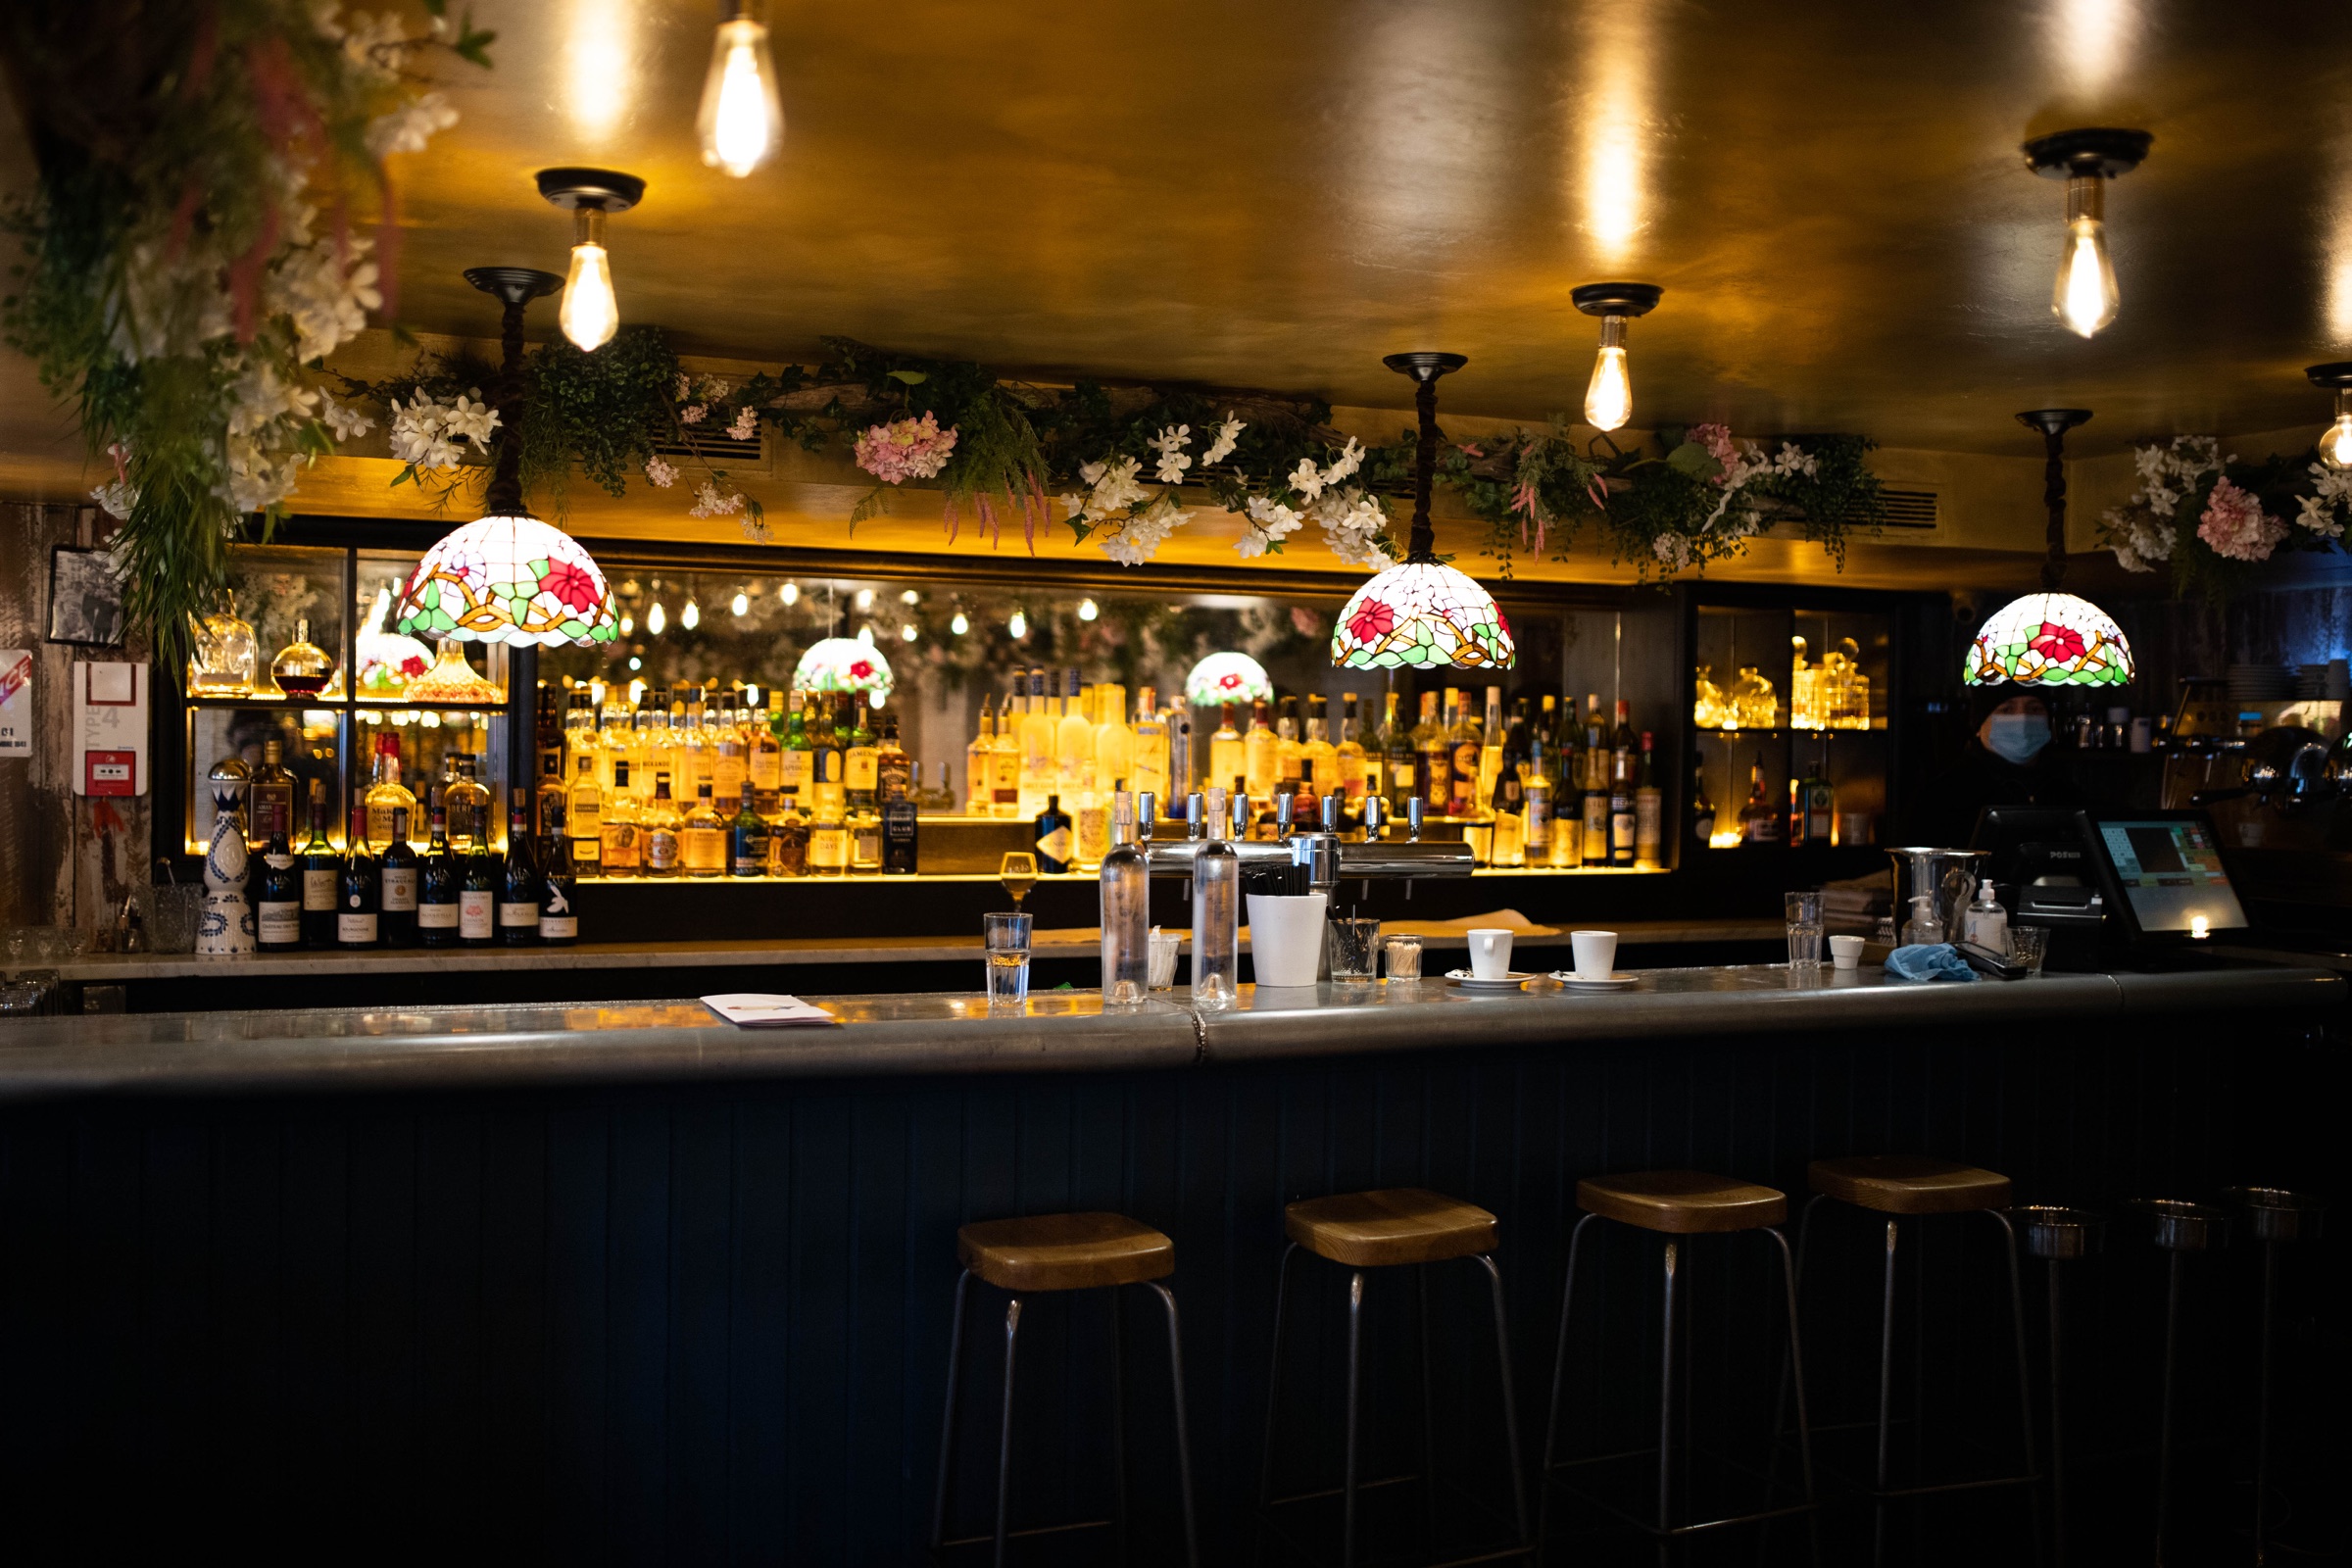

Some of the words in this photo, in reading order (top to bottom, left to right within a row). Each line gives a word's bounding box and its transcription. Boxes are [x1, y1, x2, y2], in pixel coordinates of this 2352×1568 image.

[0, 659, 29, 697] CE
[85, 706, 101, 750] TYPE
[102, 707, 121, 728] 4
